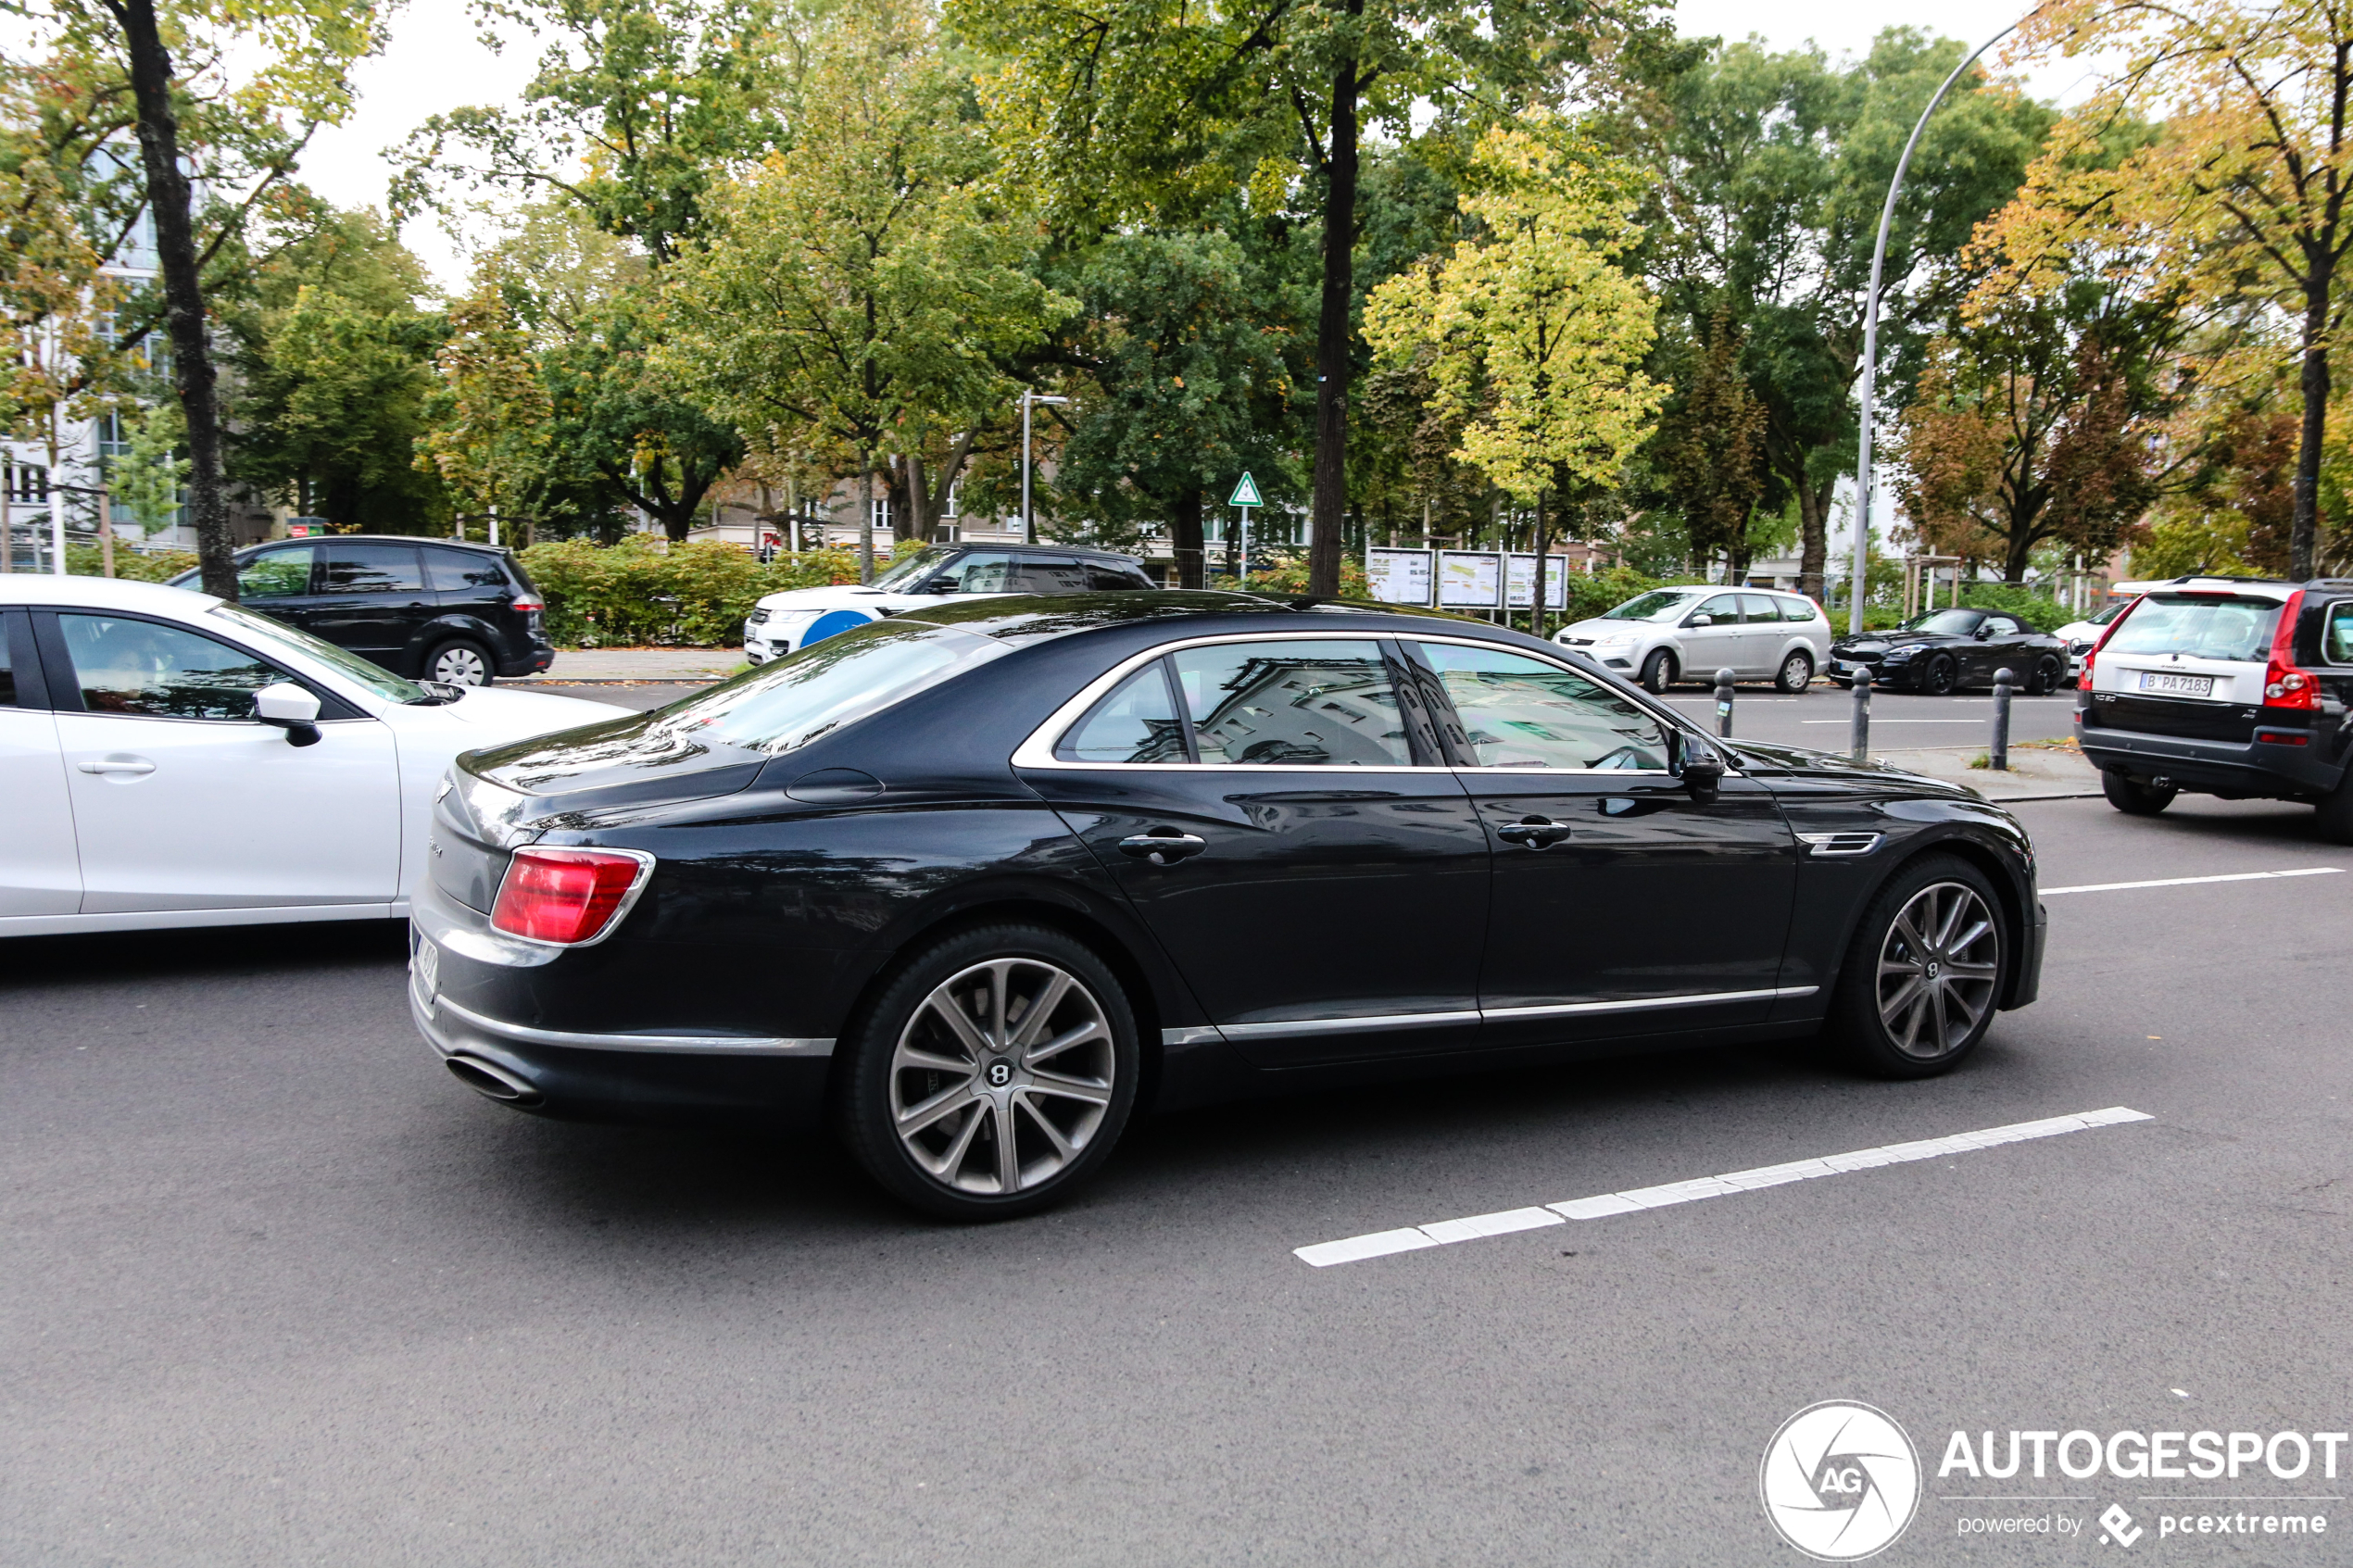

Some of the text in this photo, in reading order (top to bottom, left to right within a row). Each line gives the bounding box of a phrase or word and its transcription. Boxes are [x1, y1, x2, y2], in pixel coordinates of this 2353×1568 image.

[2147, 675, 2210, 692] B PA 7183
